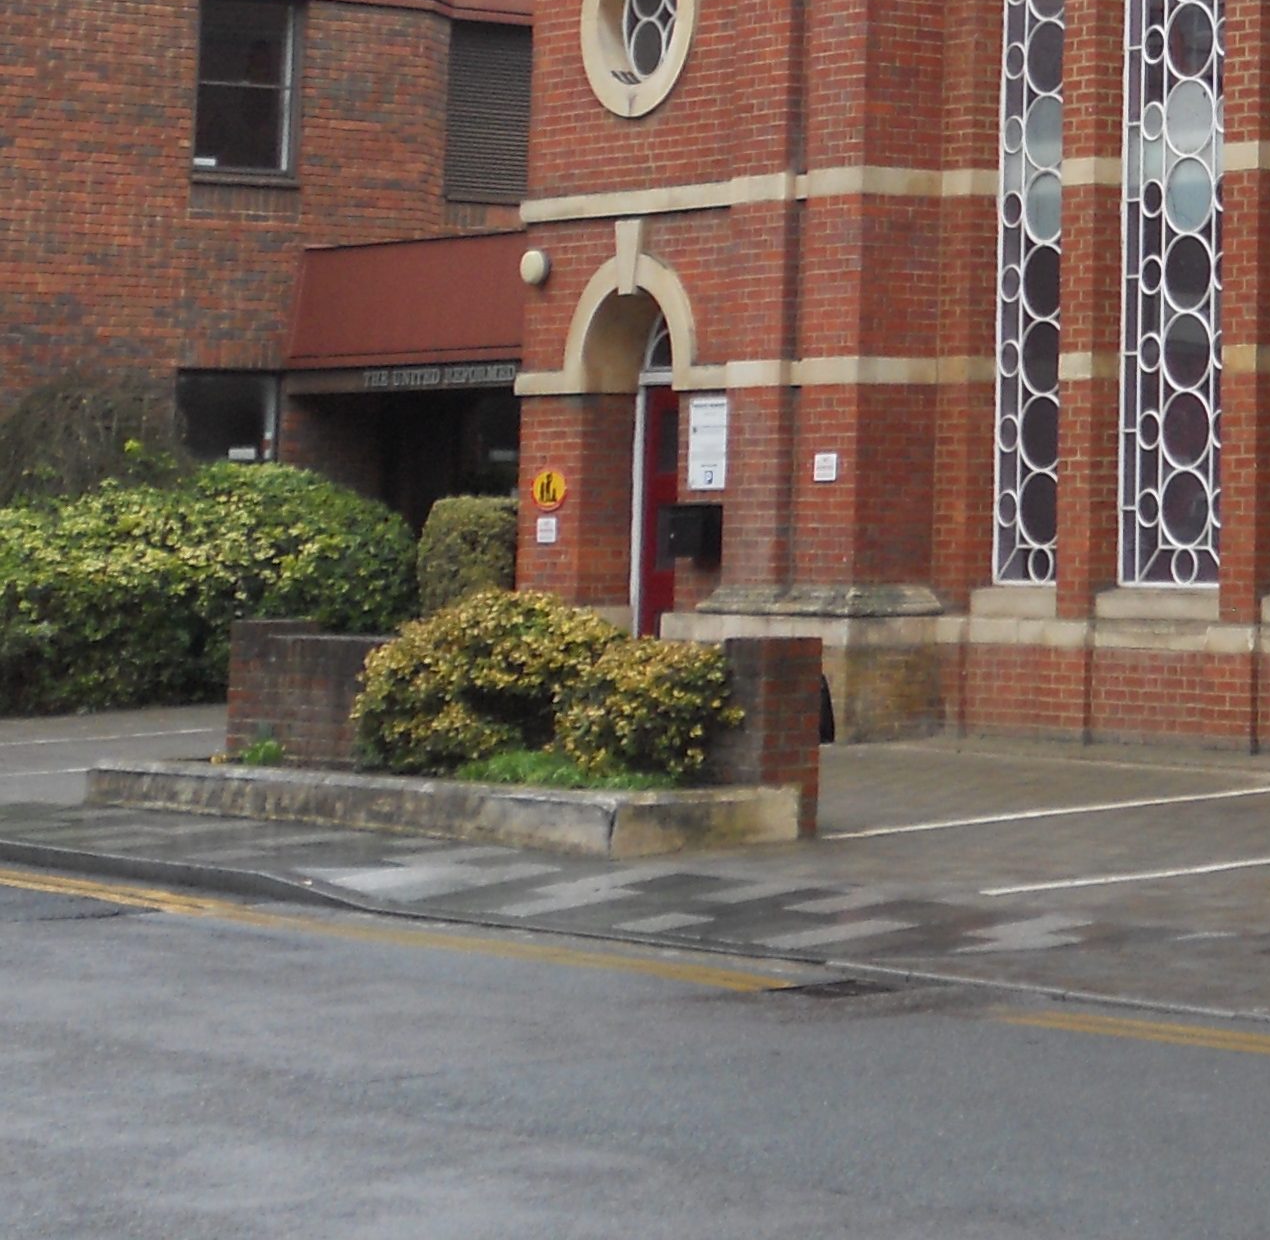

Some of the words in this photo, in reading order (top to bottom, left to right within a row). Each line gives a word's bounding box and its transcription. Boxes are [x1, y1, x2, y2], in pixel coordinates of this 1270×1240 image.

[363, 371, 389, 387] THE
[393, 368, 440, 386] UNITED
[444, 364, 516, 383] REFORMED
